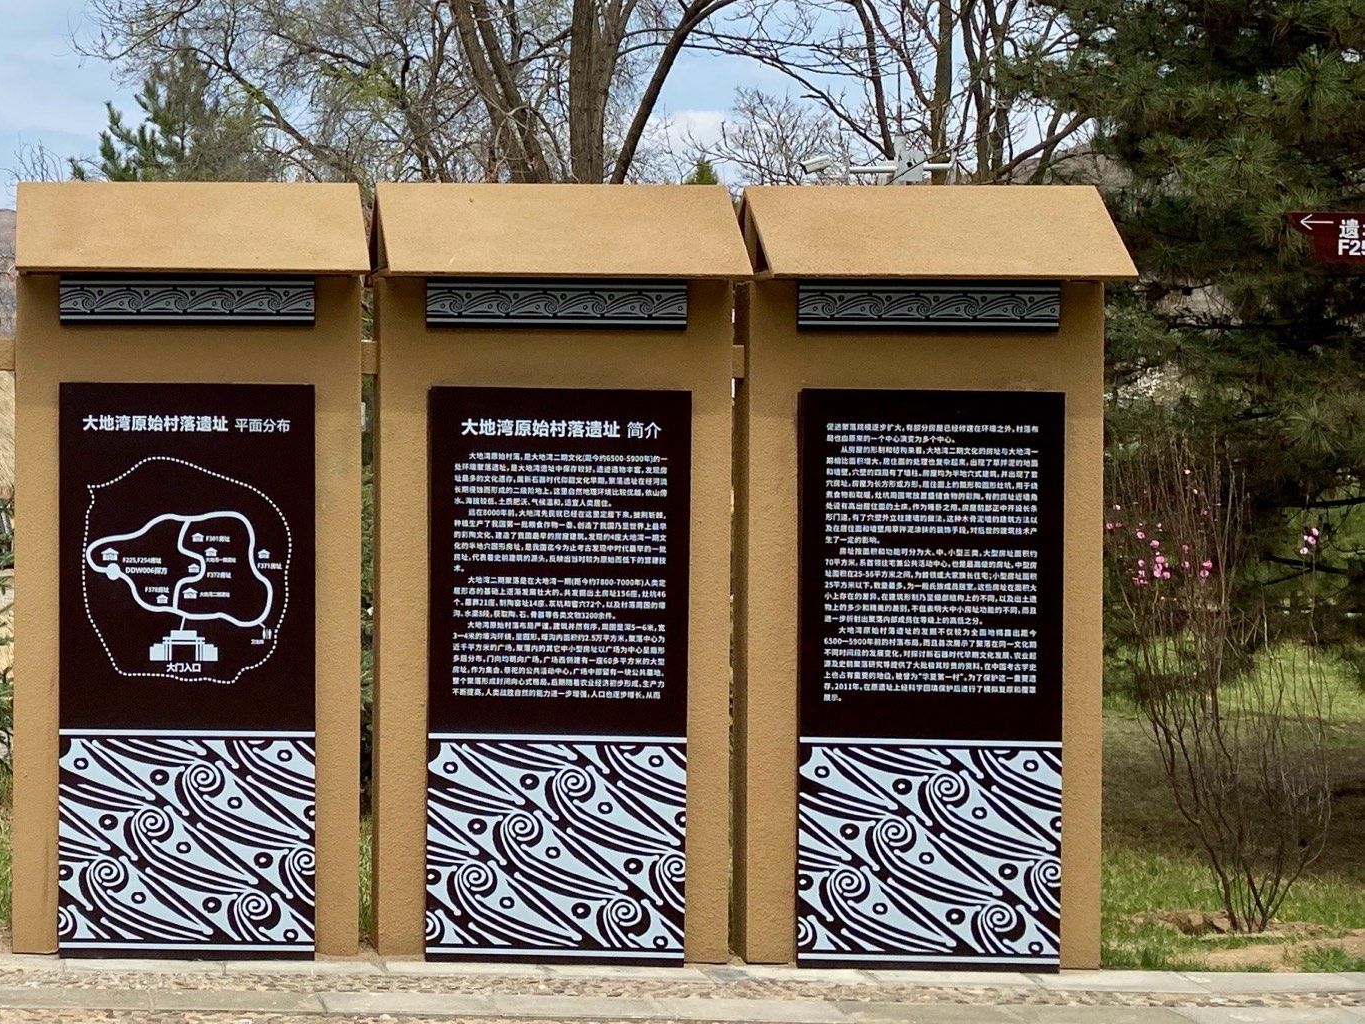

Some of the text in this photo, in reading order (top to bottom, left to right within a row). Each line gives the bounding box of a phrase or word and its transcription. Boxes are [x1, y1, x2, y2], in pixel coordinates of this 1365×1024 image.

[82, 415, 291, 432] 大地湾原始村落遗址 平面分布
[461, 419, 662, 439] 大地湾原始村落遗址 简介
[167, 662, 202, 673] 大门入口
